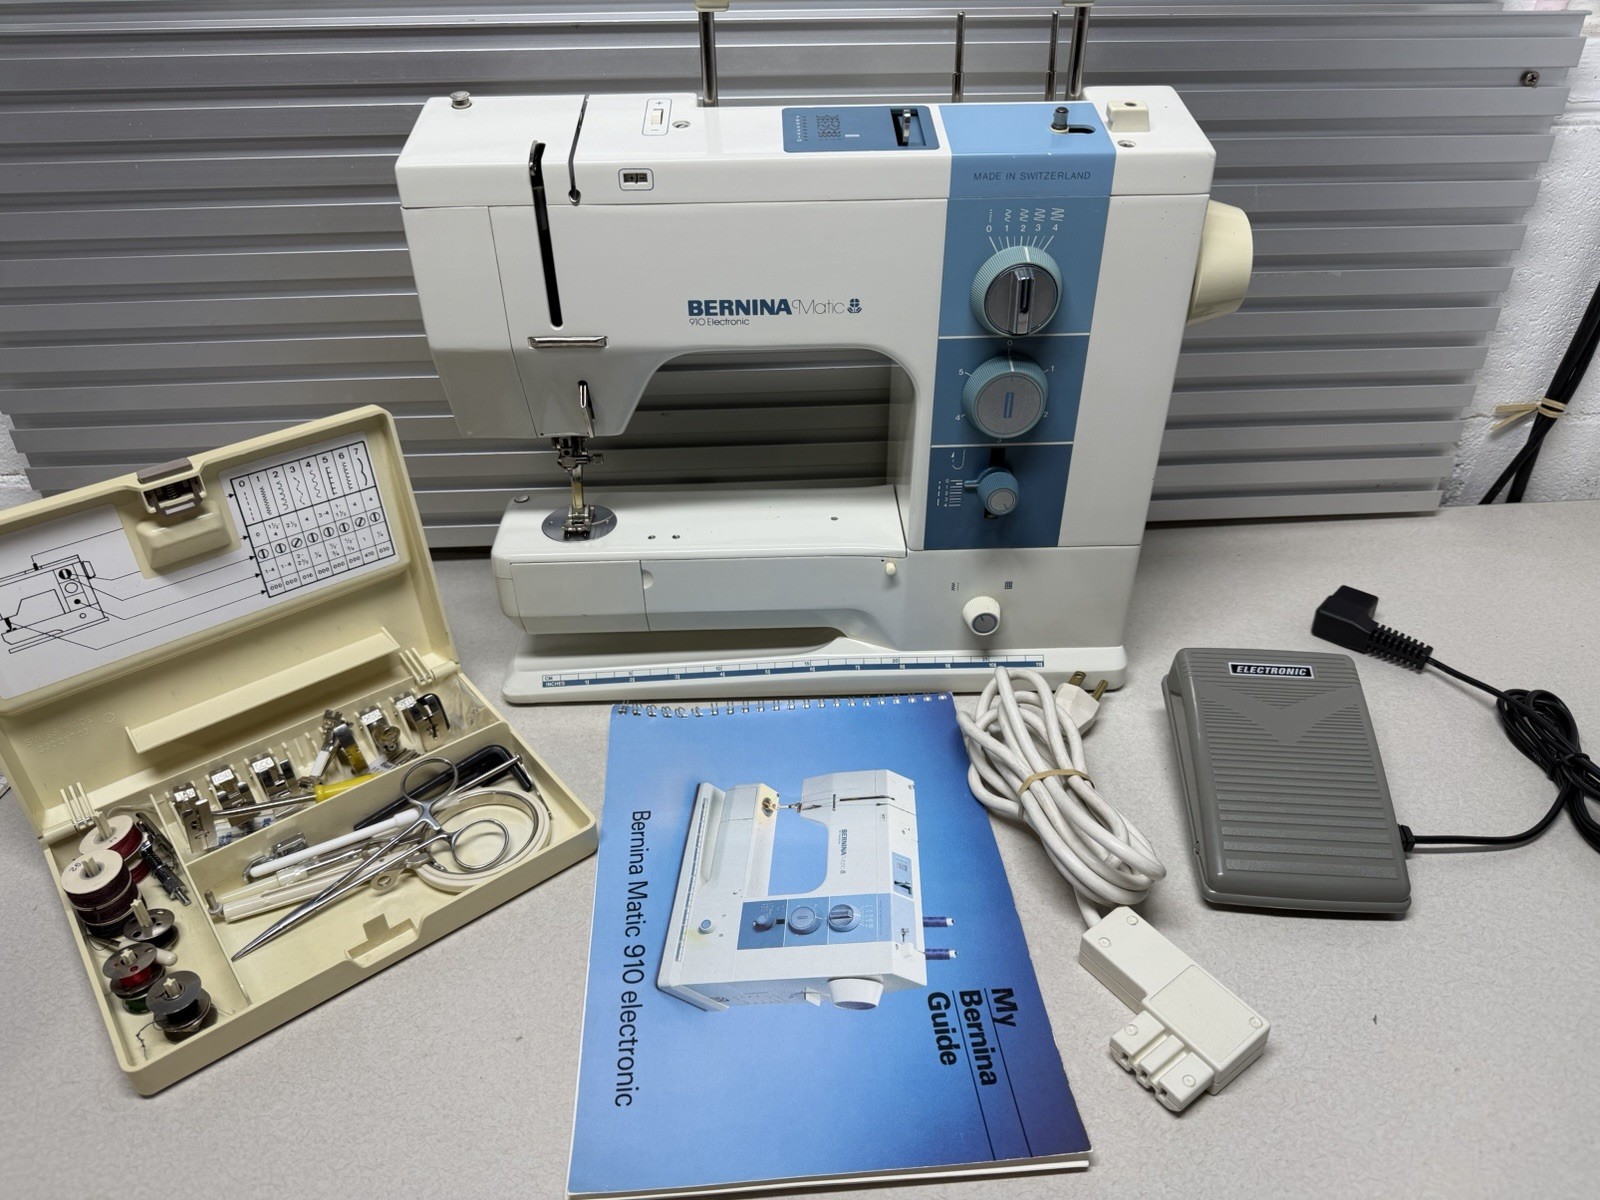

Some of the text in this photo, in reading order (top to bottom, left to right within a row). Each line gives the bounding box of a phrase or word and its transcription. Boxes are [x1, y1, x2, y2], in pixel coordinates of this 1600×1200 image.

[973, 171, 1091, 181] MADE IN SWITZERLAND
[985, 225, 993, 233] 0
[1052, 223, 1058, 231] 4
[687, 298, 845, 317] BERNINA Matic
[688, 317, 750, 326] 910 Electronic
[1236, 665, 1307, 676] ELECTRONIC
[614, 810, 651, 1107] Bernina Matic 910 electronic
[991, 988, 1018, 1027] My
[927, 991, 961, 1066] Guide
[959, 990, 997, 1086] Bernina
